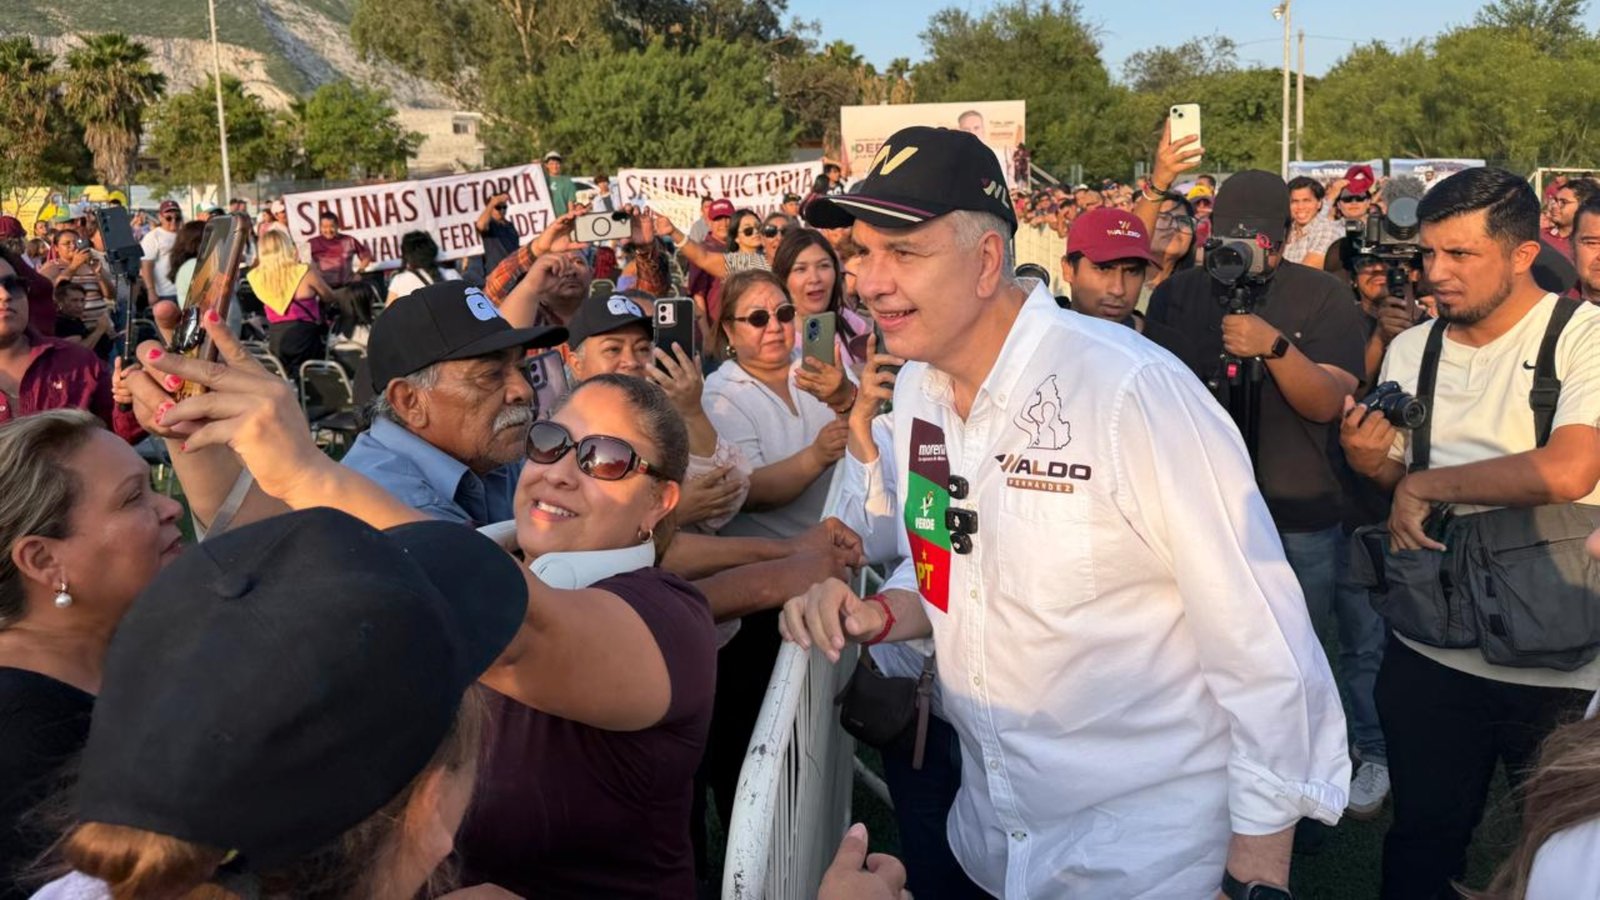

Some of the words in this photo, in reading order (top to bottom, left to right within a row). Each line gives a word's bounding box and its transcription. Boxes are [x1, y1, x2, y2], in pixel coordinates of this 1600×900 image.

[720, 168, 813, 198] VICTORIA
[297, 190, 419, 236] SALINAS
[426, 173, 540, 219] VICTORIA
[994, 454, 1092, 481] WALDO
[915, 517, 935, 531] VERDE
[916, 562, 934, 590] PT
